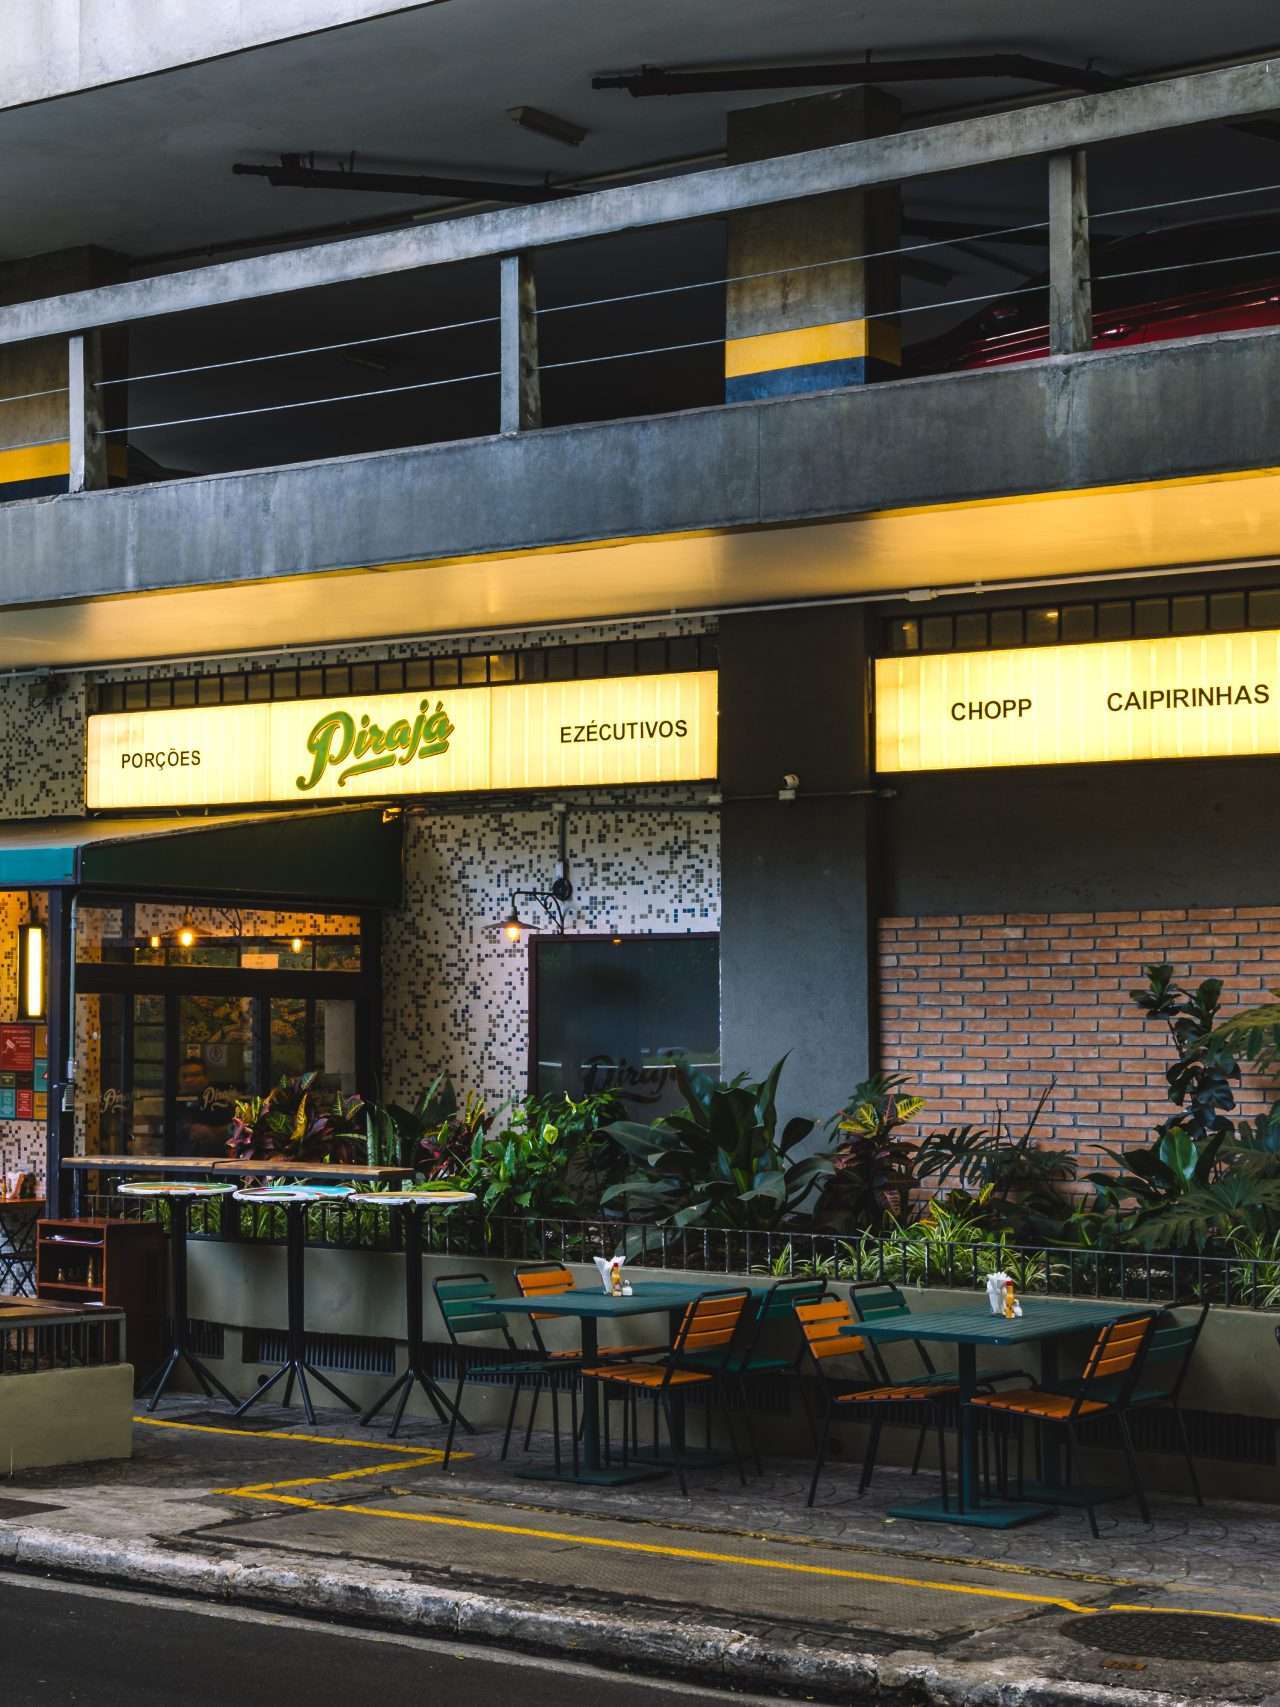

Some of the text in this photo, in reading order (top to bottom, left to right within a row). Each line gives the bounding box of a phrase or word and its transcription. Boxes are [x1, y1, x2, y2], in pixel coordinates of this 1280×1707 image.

[951, 684, 1270, 721] CHOPP CAIPIRINHAS
[121, 699, 688, 791] PORÇÕES Pirajá EZÉCUTIVOS
